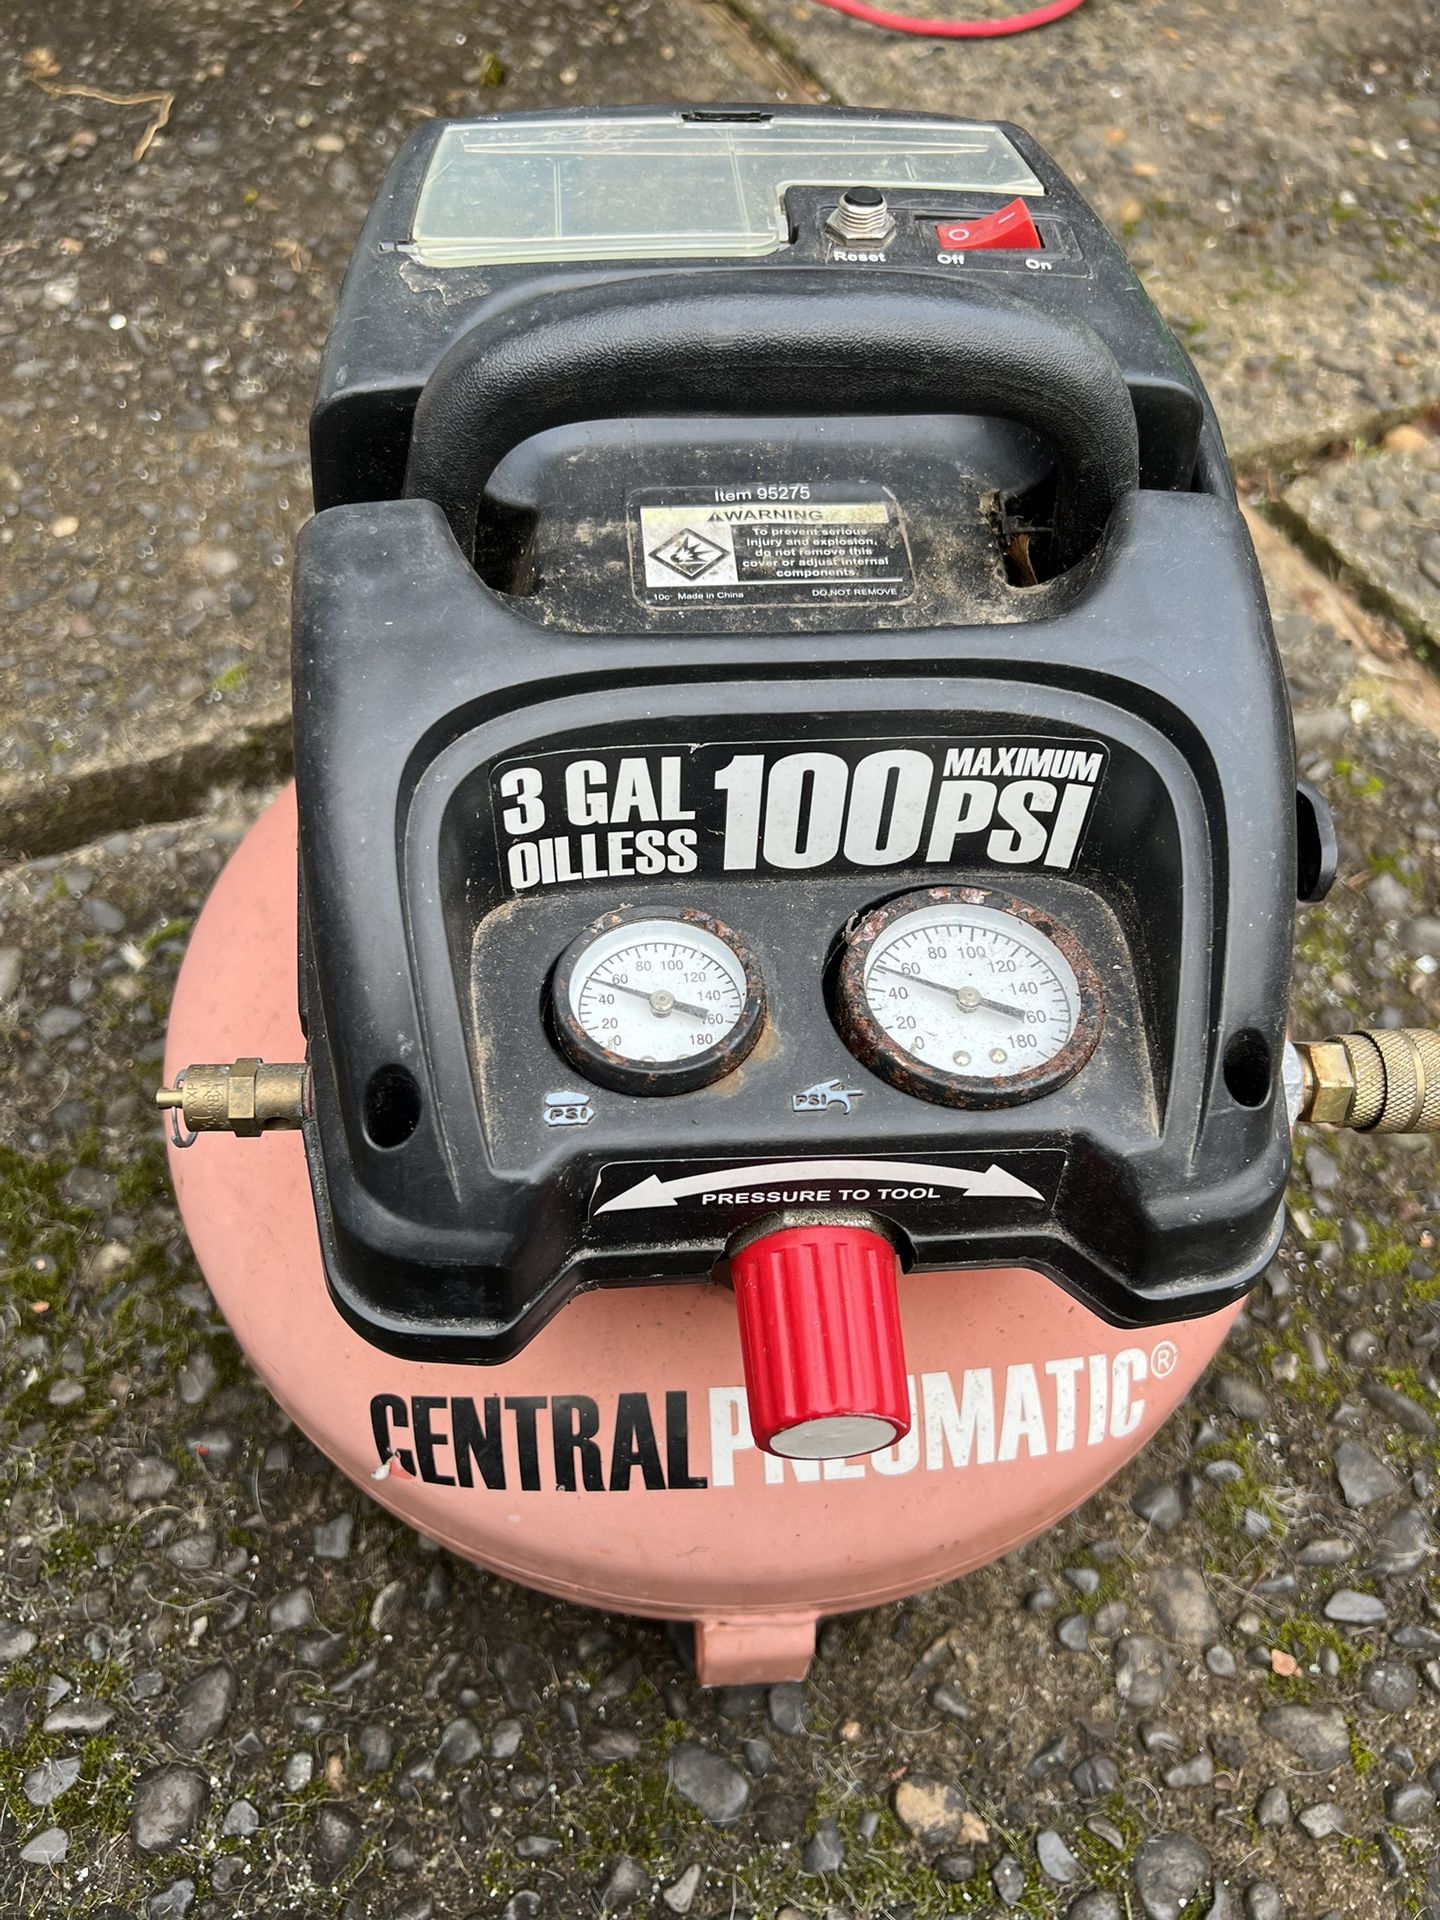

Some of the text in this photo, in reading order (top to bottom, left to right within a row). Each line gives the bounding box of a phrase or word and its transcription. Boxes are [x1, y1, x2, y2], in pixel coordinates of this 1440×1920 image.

[834, 251, 887, 263] Reset
[937, 253, 964, 265] Off
[1025, 258, 1052, 270] On
[714, 486, 810, 502] Item 95275
[724, 509, 823, 521] WARNING
[752, 526, 867, 537] To prevent serious
[746, 537, 782, 547] injury
[786, 537, 809, 546] and
[755, 547, 873, 557] do not remove this
[742, 557, 889, 568] cover or adjust internal
[776, 568, 859, 579] components.
[677, 592, 704, 600] Made
[706, 592, 715, 600] in
[717, 591, 744, 599] China
[811, 588, 898, 597] DO NOT REMOVE
[941, 746, 1104, 783] MAXIMUM
[500, 756, 697, 836] 3 GAL
[714, 749, 934, 870] 100
[924, 778, 1095, 870] PSI
[507, 827, 698, 890] OILLESS
[927, 947, 947, 959] 80
[958, 946, 986, 959] 100
[635, 961, 652, 971] 80
[660, 960, 684, 971] 100
[901, 962, 921, 976] 60
[988, 960, 1016, 973] 120
[612, 974, 628, 985] 60
[683, 972, 706, 983] 120
[888, 987, 908, 999] 40
[1009, 982, 1039, 995] 140
[599, 994, 615, 1005] 40
[697, 990, 721, 1001] 140
[601, 1018, 618, 1029] 20
[896, 1016, 917, 1029] 20
[613, 1035, 622, 1046] 0
[689, 1033, 713, 1045] 180
[914, 1036, 925, 1050] 0
[1007, 1034, 1037, 1048] 180
[796, 1093, 827, 1106] PSI
[550, 1107, 587, 1120] PSI
[702, 1187, 941, 1206] PRESSURE TO TOOL
[370, 1391, 709, 1491] CENTRAL
